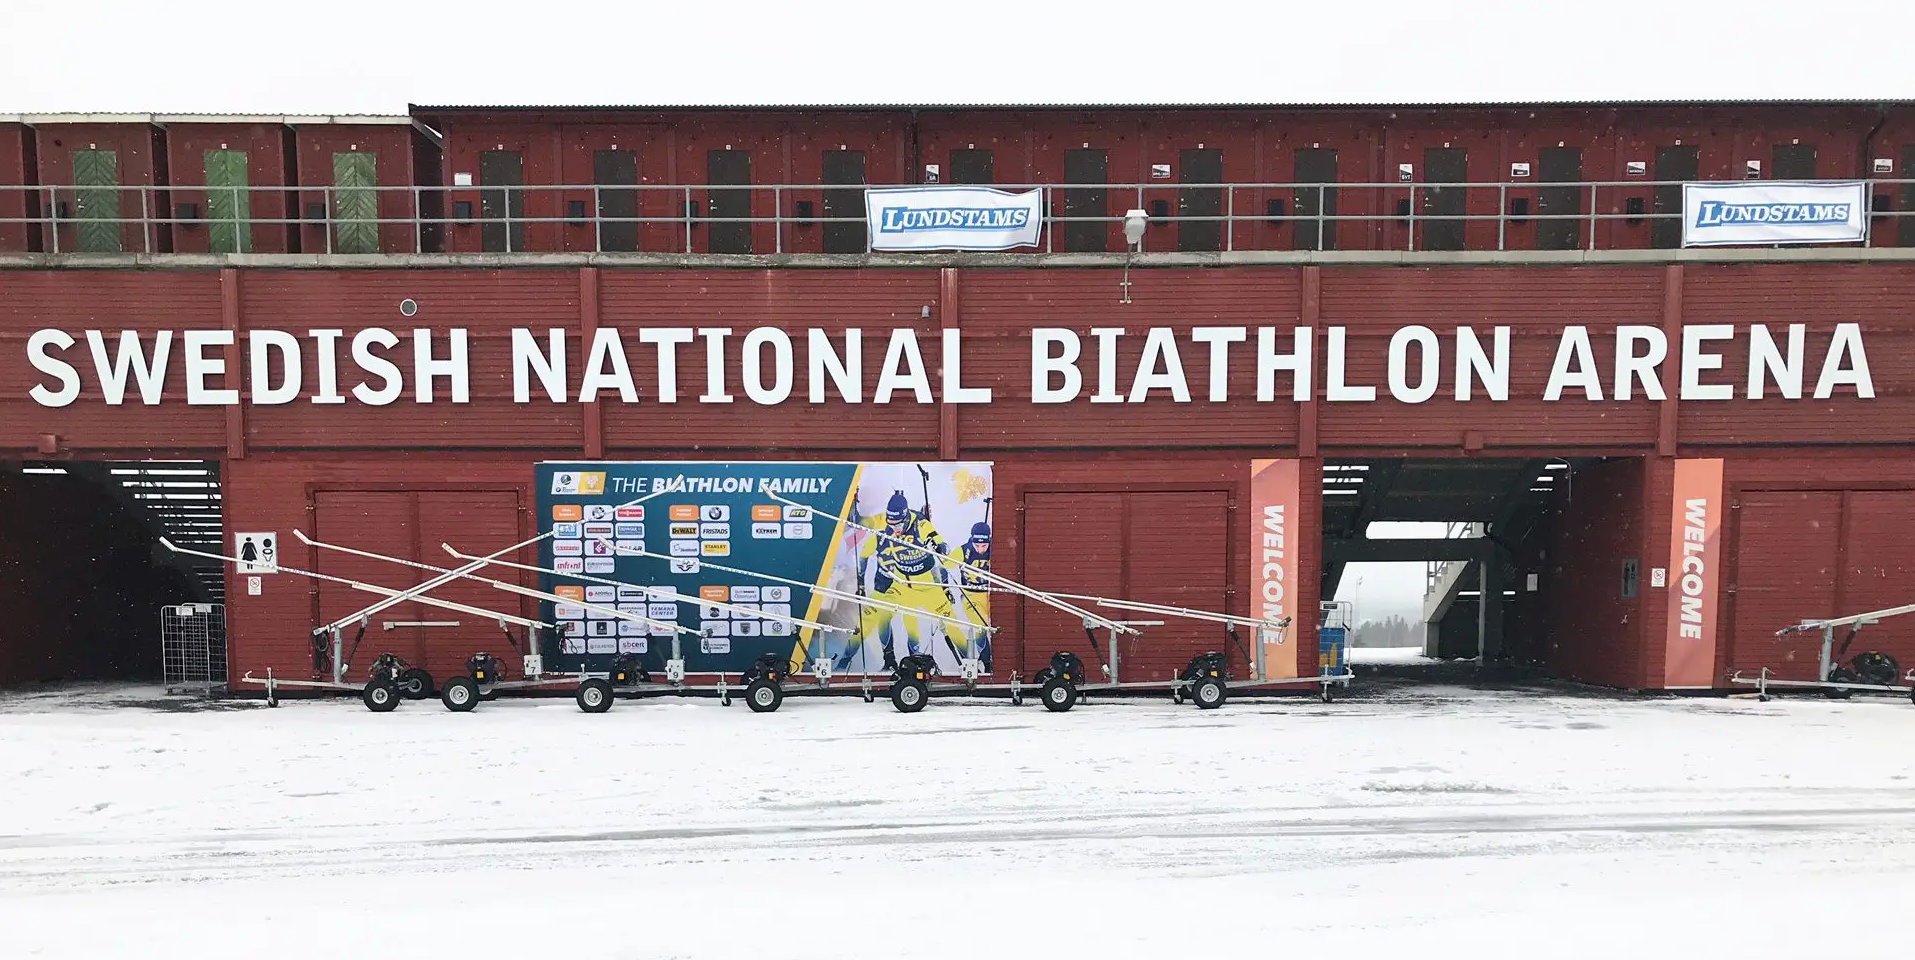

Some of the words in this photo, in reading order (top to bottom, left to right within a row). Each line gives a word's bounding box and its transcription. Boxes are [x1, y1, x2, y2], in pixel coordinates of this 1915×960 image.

[882, 208, 1029, 231] LUNDSTAMS
[1699, 203, 1850, 225] LUNDSTAMS
[27, 328, 469, 406] SWEDISH
[512, 327, 991, 404] NATIONAL
[1032, 326, 1510, 403] BIATHLON
[1543, 323, 1875, 400] ARENA
[612, 477, 648, 493] THE
[651, 477, 752, 493] BIATHLON
[757, 477, 833, 493] FAMILY
[1262, 504, 1285, 646] WELCOME
[1680, 498, 1707, 640] WELCOME
[673, 671, 678, 679] 9
